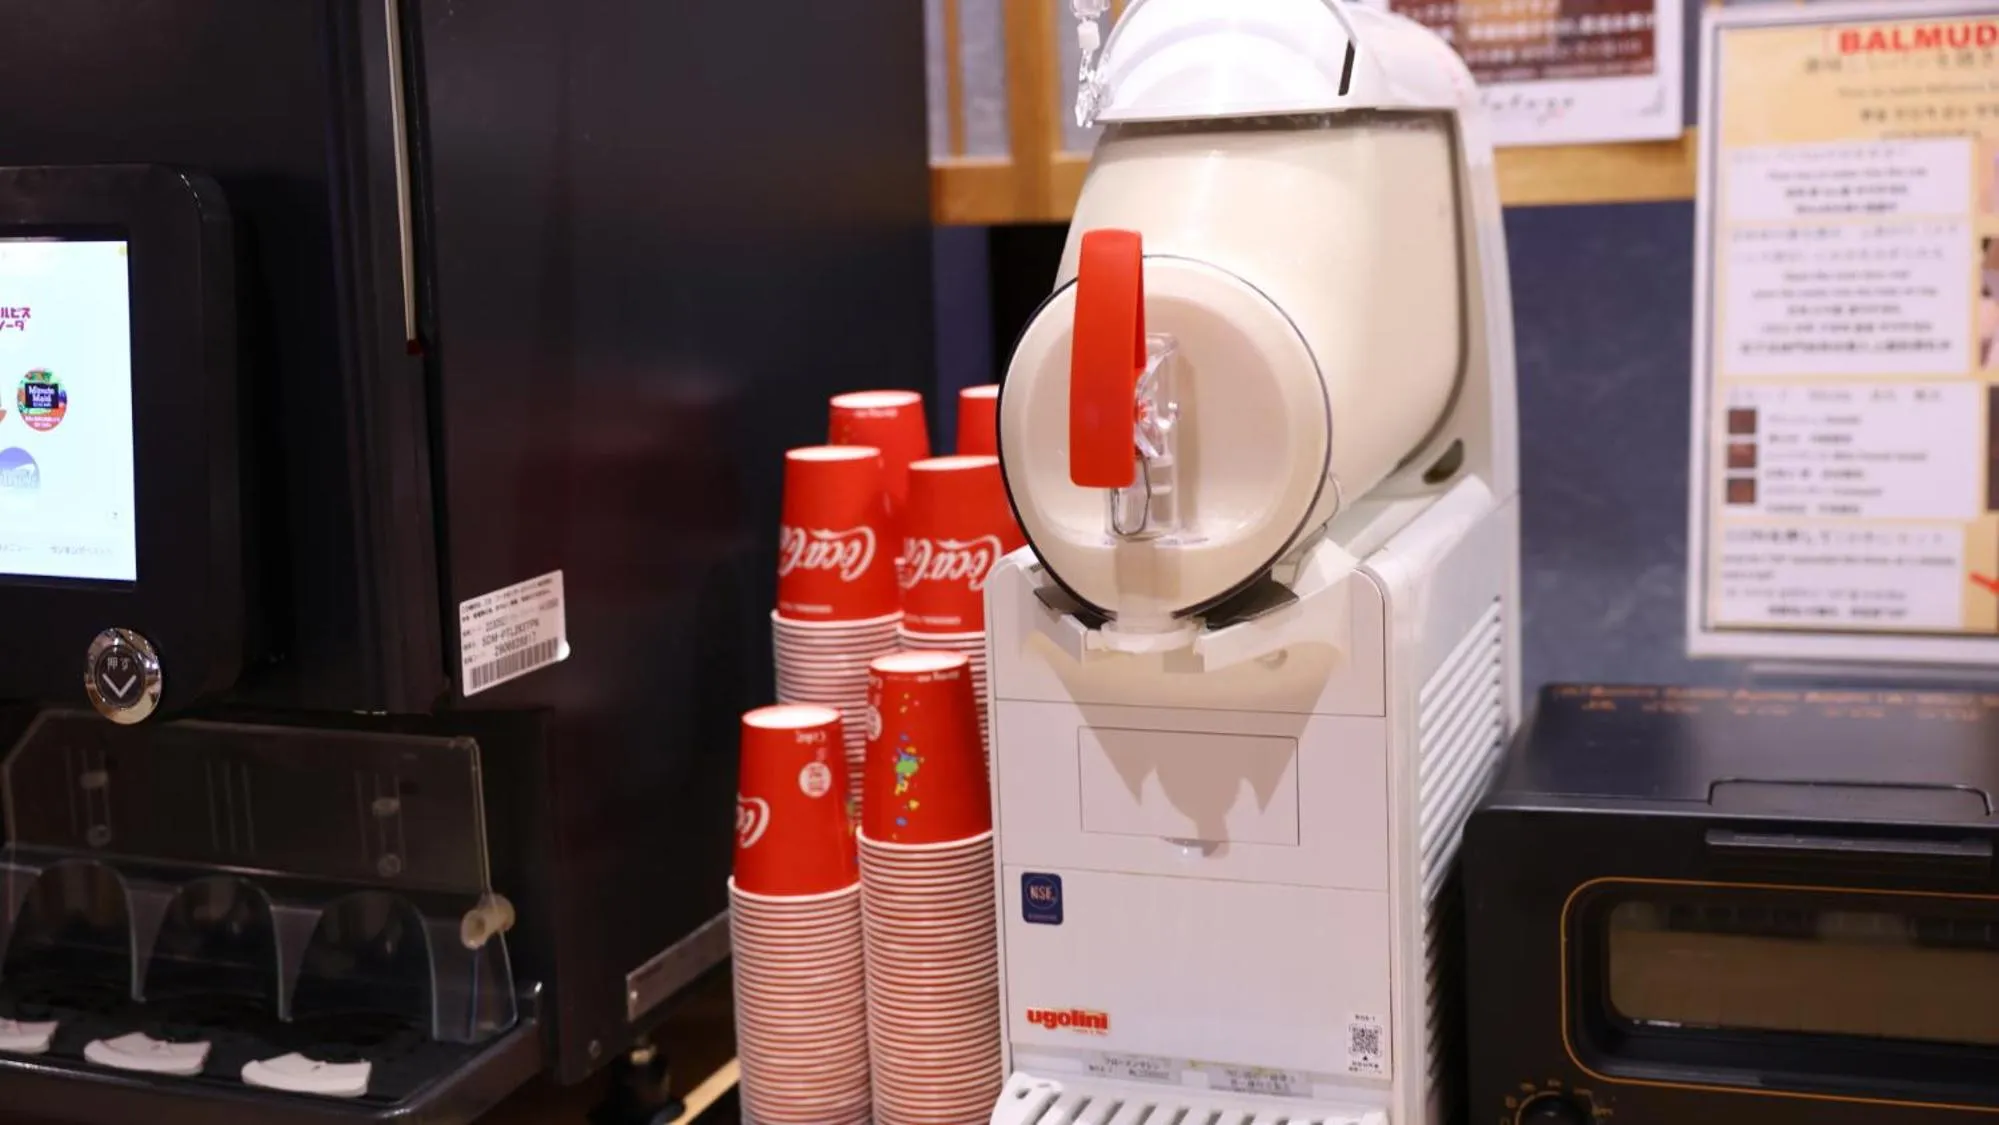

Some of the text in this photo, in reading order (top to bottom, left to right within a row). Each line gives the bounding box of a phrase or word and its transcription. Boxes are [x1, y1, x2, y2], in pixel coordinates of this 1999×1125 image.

[1839, 25, 1998, 56] BALMUD
[107, 657, 129, 672] 押す
[1027, 1009, 1108, 1030] ugolini
